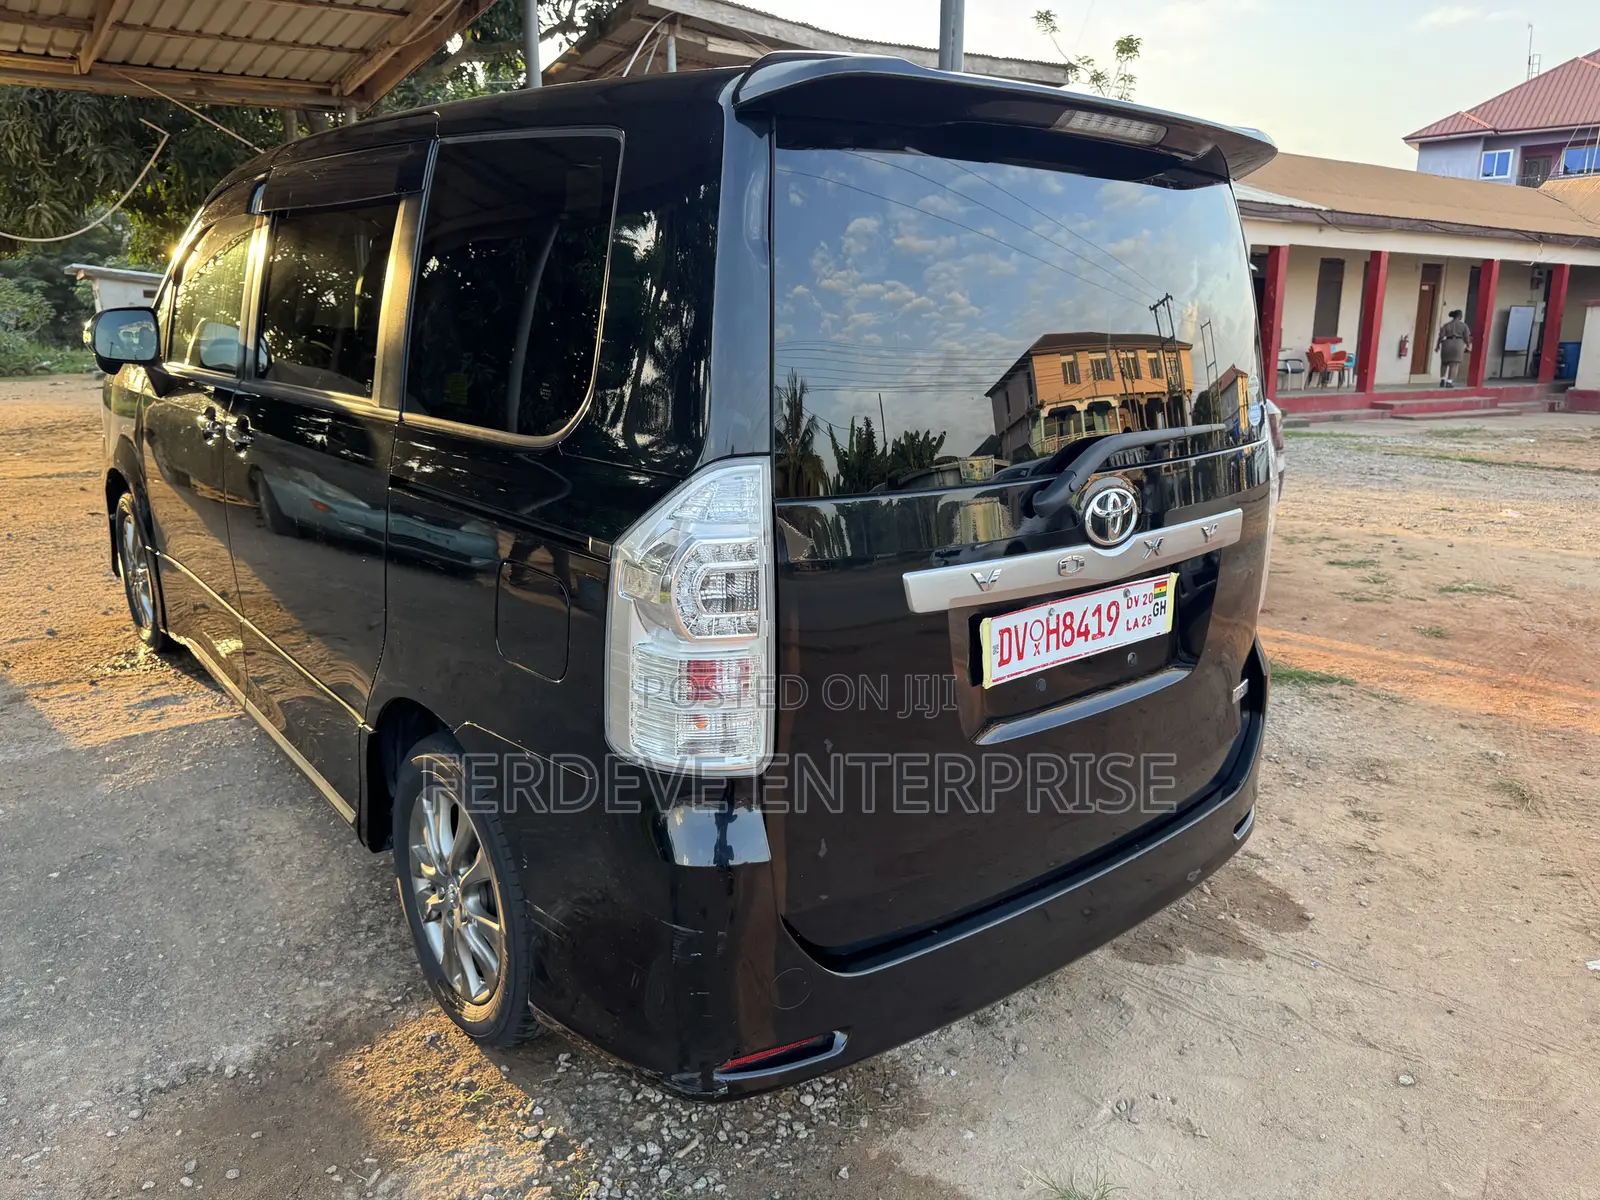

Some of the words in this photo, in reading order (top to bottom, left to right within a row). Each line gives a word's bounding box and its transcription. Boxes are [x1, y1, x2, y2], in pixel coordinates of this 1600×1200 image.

[971, 522, 1218, 592] VOXY
[1126, 594, 1140, 610] DV
[1142, 591, 1154, 606] 20
[1153, 599, 1167, 617] GH
[1126, 617, 1139, 632] LA
